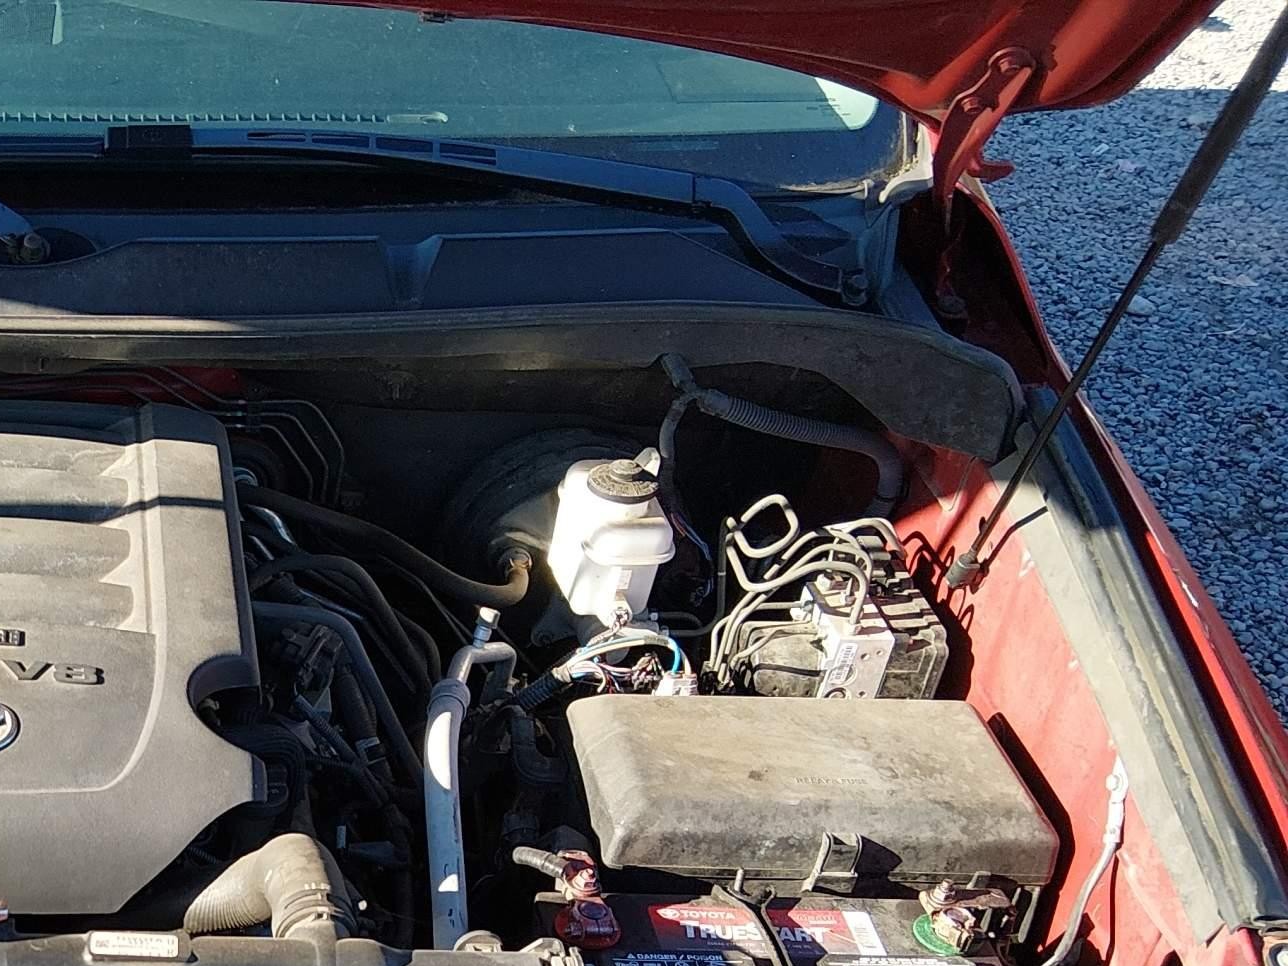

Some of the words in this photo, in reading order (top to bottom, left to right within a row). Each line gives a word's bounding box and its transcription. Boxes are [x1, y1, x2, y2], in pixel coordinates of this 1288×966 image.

[1, 659, 106, 685] V8
[682, 908, 736, 920] TOYOTA
[680, 921, 825, 944] TRUESART
